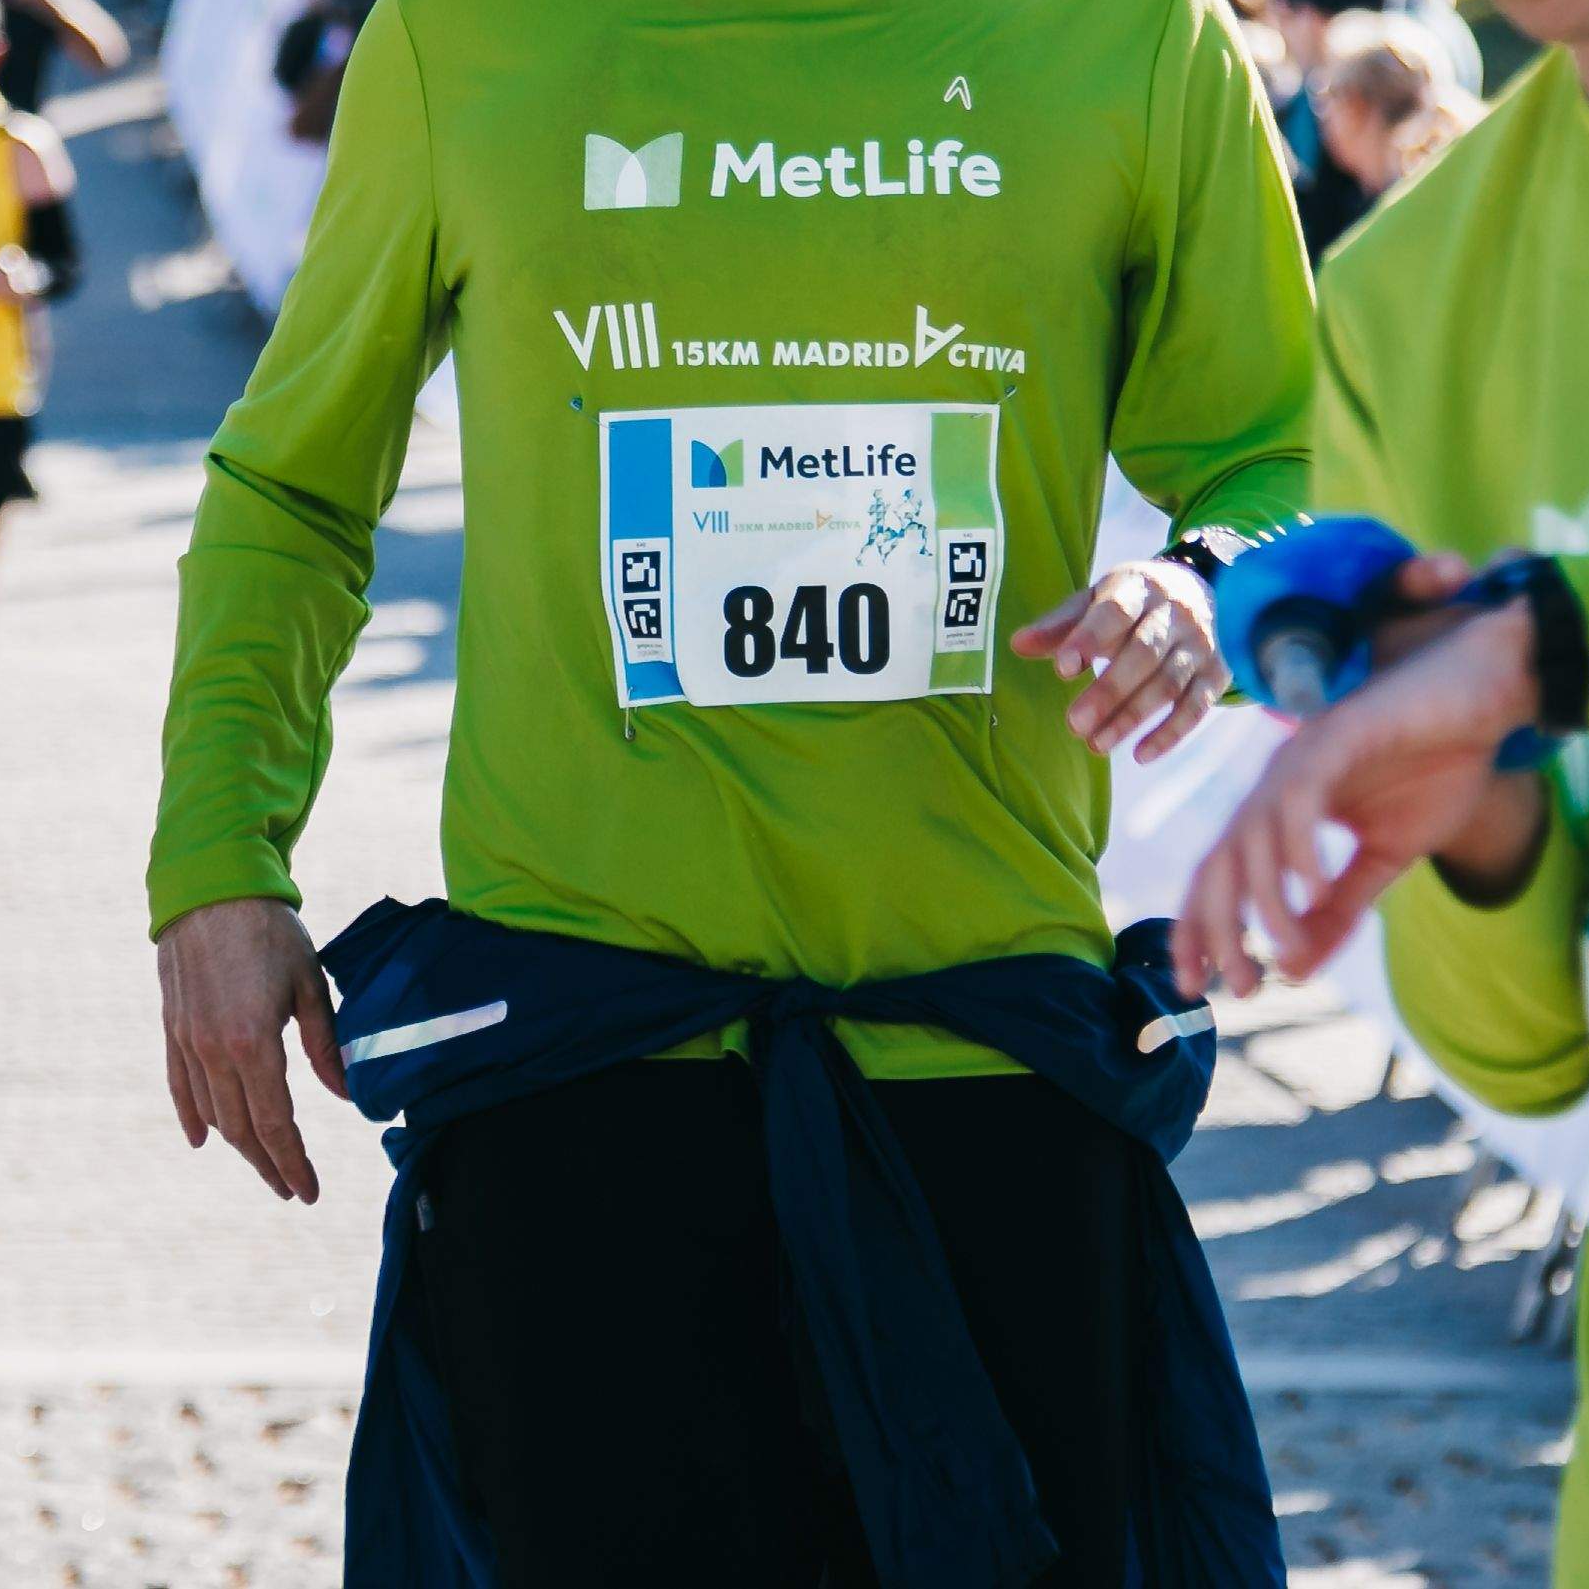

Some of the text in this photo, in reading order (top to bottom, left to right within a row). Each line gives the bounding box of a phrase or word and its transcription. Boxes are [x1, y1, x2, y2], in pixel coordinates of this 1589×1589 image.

[710, 138, 1002, 199] MetLife
[552, 301, 661, 372] VIII
[671, 341, 761, 368] 15KM
[759, 443, 917, 479] MetLife
[692, 510, 730, 534] VIII
[723, 582, 891, 678] 840
